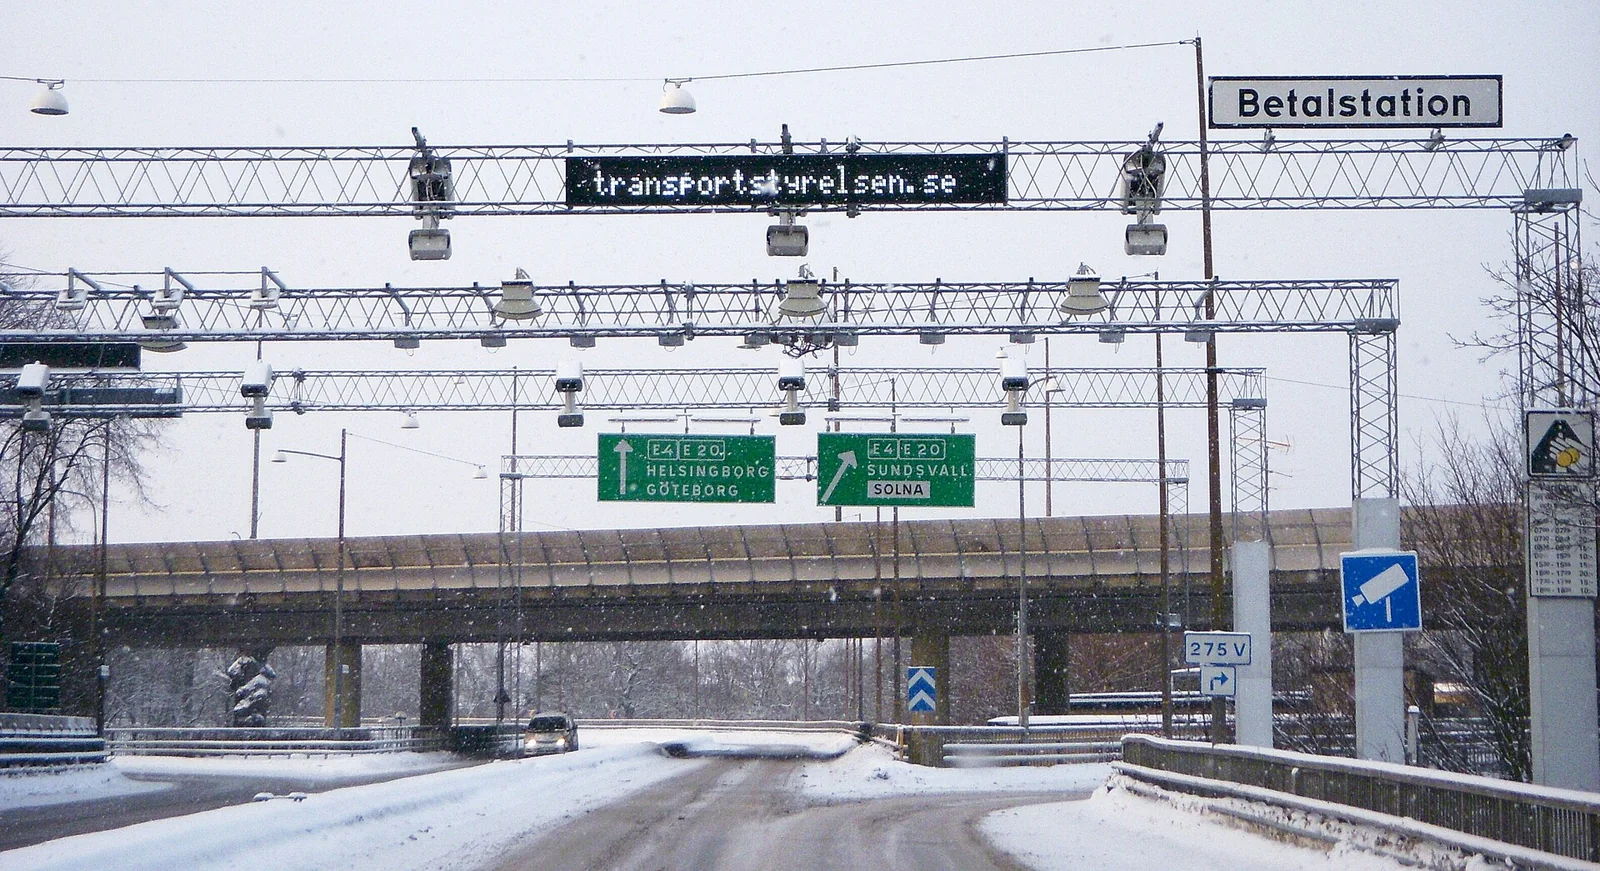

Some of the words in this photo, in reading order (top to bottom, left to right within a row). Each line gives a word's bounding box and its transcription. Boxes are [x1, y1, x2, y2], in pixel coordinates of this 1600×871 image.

[1239, 88, 1471, 117] Betalstation
[653, 444, 673, 457] E4
[683, 444, 691, 456] E
[698, 444, 720, 456] 20
[873, 443, 893, 455] E4
[904, 444, 911, 455] E
[918, 444, 940, 455] 20
[646, 465, 769, 478] HELSINGBORG
[867, 464, 967, 476] SUNDSVALL
[646, 481, 738, 496] GÖTEBORG
[874, 484, 924, 496] SOLNA
[1190, 642, 1227, 656] 275
[1233, 642, 1246, 656] V
